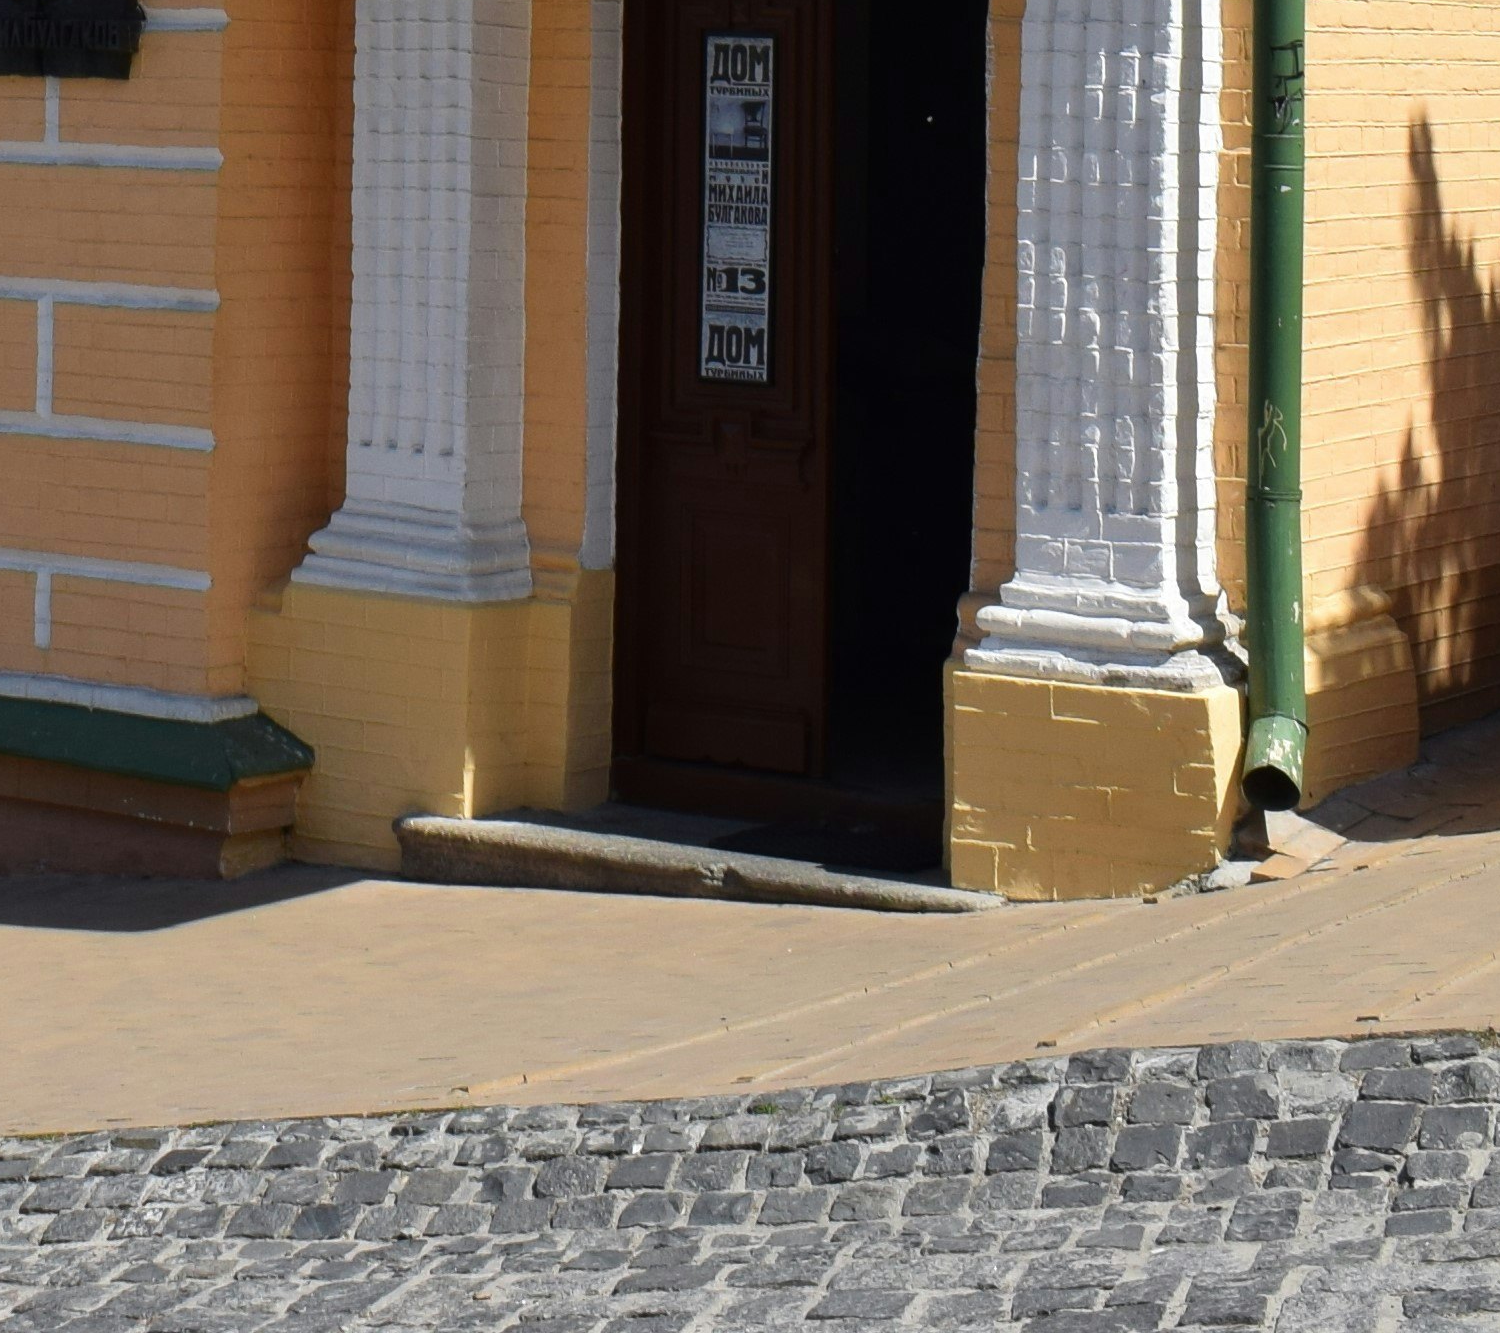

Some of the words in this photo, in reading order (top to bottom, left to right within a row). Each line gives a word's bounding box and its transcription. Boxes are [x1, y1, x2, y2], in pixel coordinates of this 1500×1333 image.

[710, 43, 771, 85] ДОМ
[709, 86, 770, 98] ТУРБИНЫХ
[708, 184, 769, 205] МИХАИЛА
[708, 203, 768, 225] БУЛГАКОВА
[705, 324, 765, 366] ДОМ
